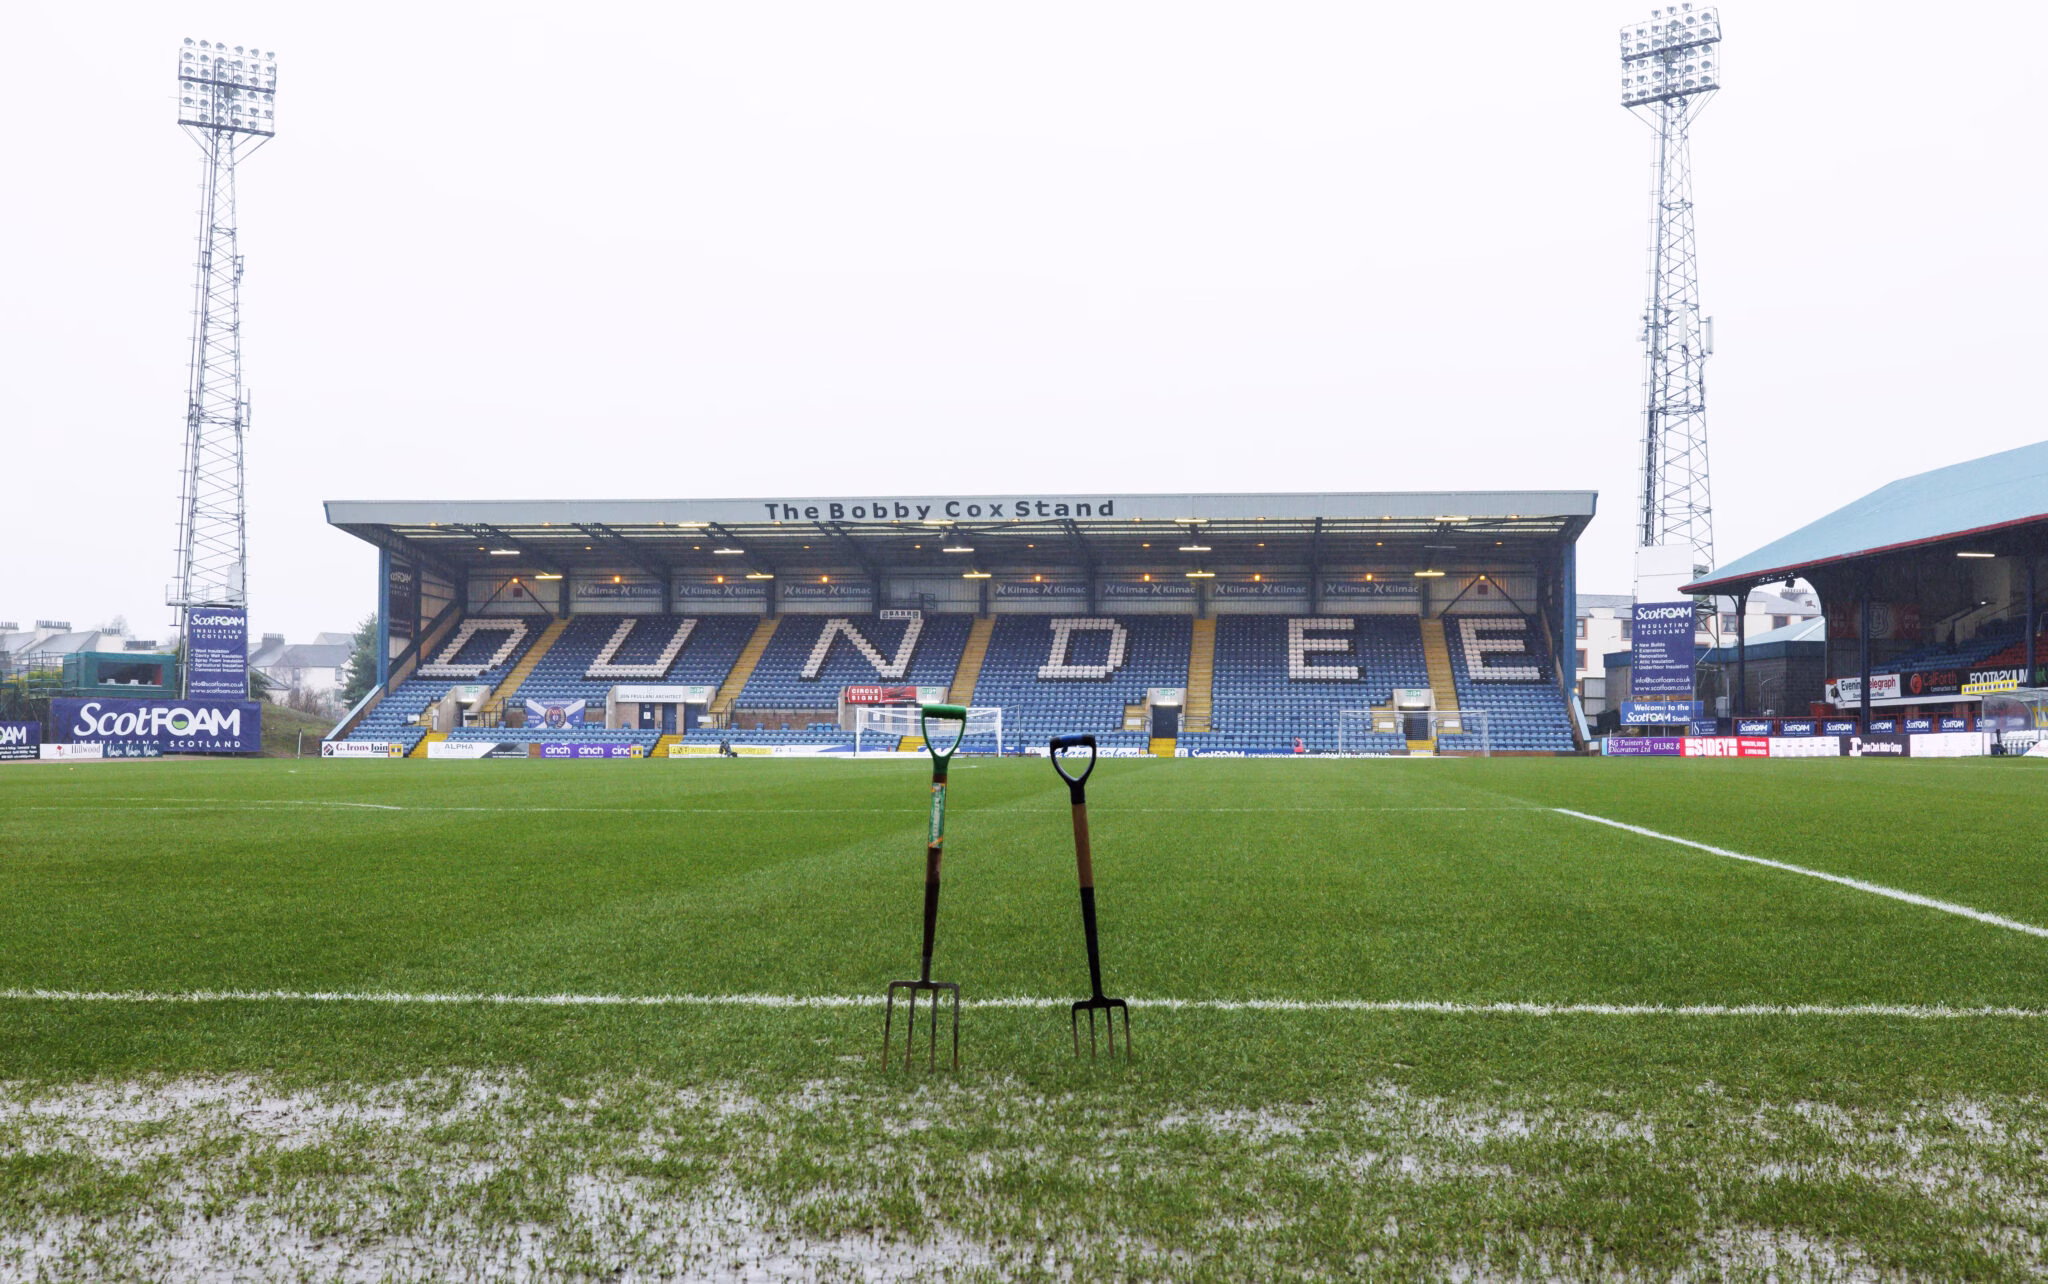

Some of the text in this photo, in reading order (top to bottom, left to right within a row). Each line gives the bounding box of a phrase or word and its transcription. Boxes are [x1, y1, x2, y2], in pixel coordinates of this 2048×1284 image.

[765, 500, 1114, 521] The Bobby Cox Stand
[691, 586, 766, 595] Kilmac Kilmac
[795, 585, 871, 595] Kilmac Kilmac
[1007, 586, 1086, 594] Kilmac Kilmac
[1116, 585, 1195, 594] Kilmac Kilmac
[1226, 585, 1306, 594] Kilmac Kilmac
[1338, 585, 1419, 594] Kilmac Kilmac
[1636, 607, 1692, 620] ScotFOAM
[191, 614, 244, 626] ScotFOAM
[1841, 677, 1896, 691] Evenin elegraph
[1677, 703, 1689, 711] the
[73, 702, 241, 737] ScotFOAM
[1626, 712, 1671, 722] ScotFOAM
[1826, 722, 1852, 731] ScotFOAM
[1870, 722, 1892, 730] cotFOAM
[1906, 720, 1929, 729] ScotFOAM
[1942, 719, 1964, 729] ScotFOAM
[170, 740, 241, 748] SCOTLAND
[347, 743, 369, 751] Irons
[1695, 738, 1729, 756] SIDEY
[72, 745, 101, 754] Hillwood
[545, 744, 630, 755] cinch cinch cinc
